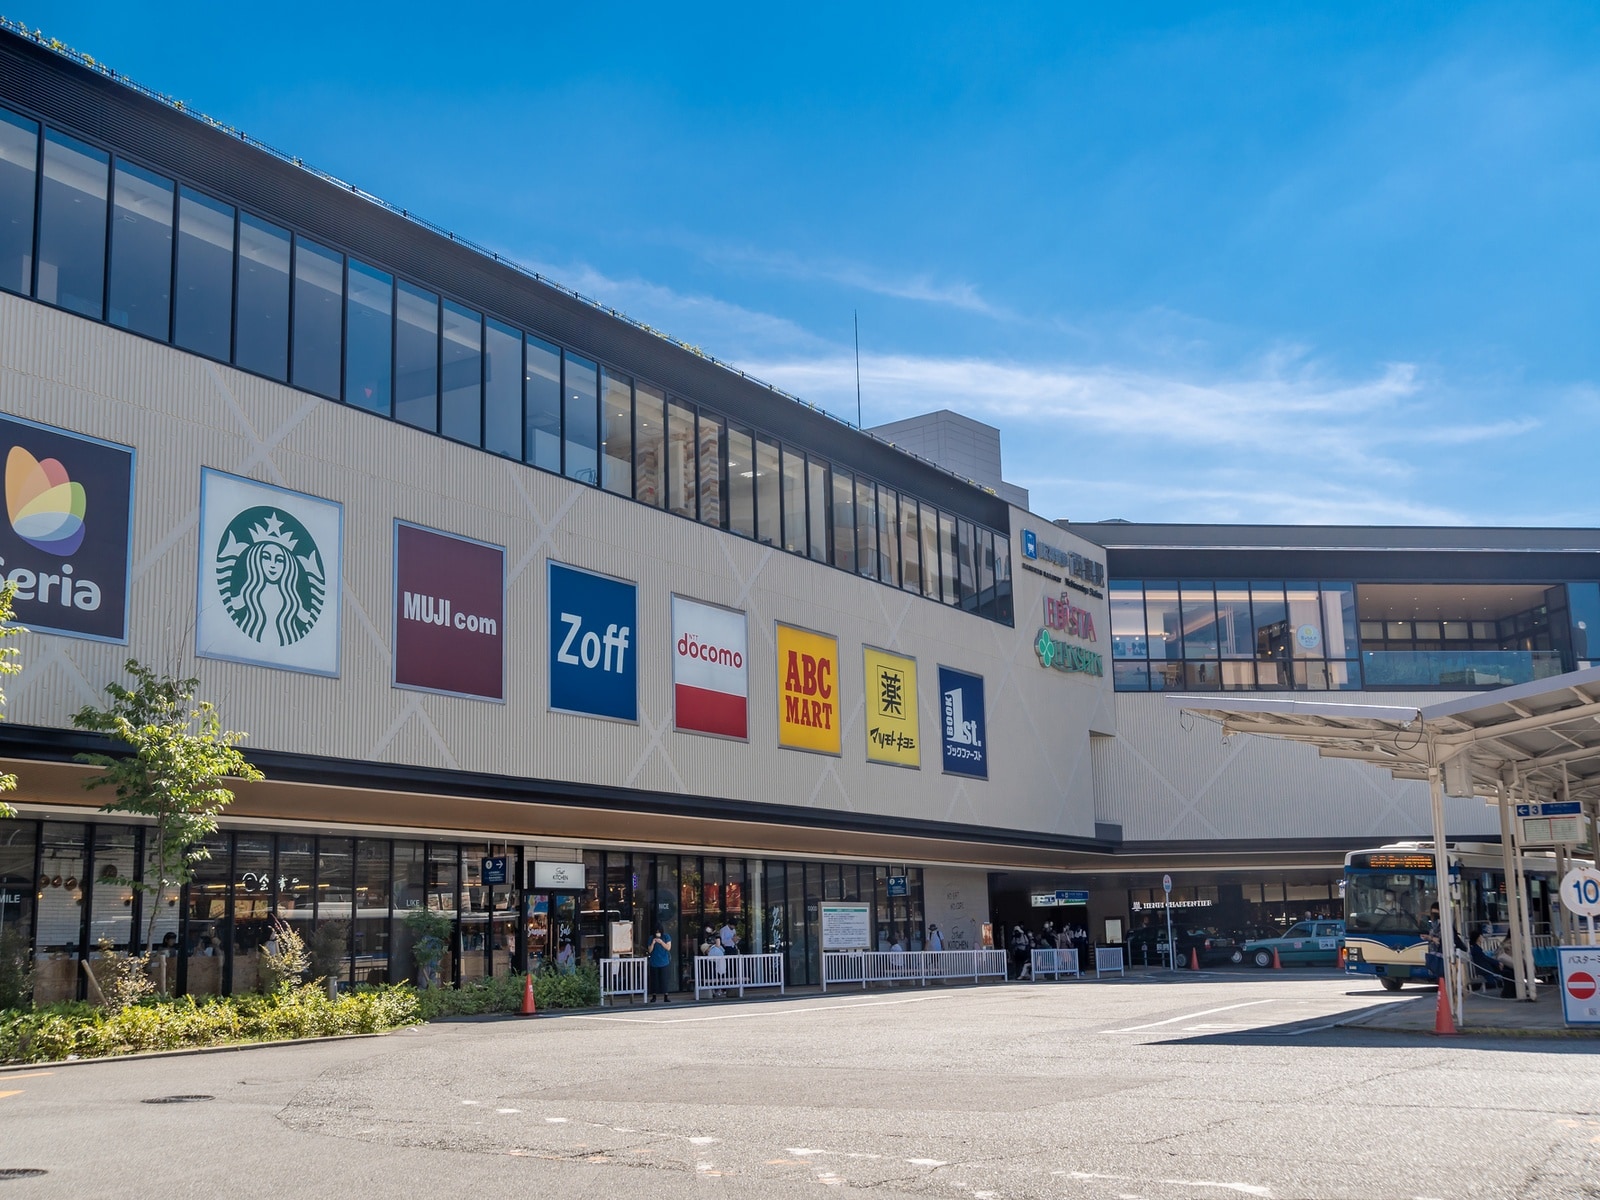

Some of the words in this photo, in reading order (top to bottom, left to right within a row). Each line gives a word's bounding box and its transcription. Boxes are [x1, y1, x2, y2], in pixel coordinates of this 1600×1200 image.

[0, 557, 101, 611] eria
[403, 591, 450, 627] MUJI
[454, 612, 497, 635] com
[557, 612, 630, 674] Zoff
[677, 632, 743, 669] docomo
[785, 650, 832, 700] ABC
[881, 671, 902, 715] 薬
[785, 695, 832, 730] MART
[945, 695, 954, 736] BOOK
[870, 727, 916, 752] マツモトキヨシ
[946, 744, 982, 761] ブックファースト
[1531, 805, 1539, 815] 3
[1572, 879, 1599, 905] 10
